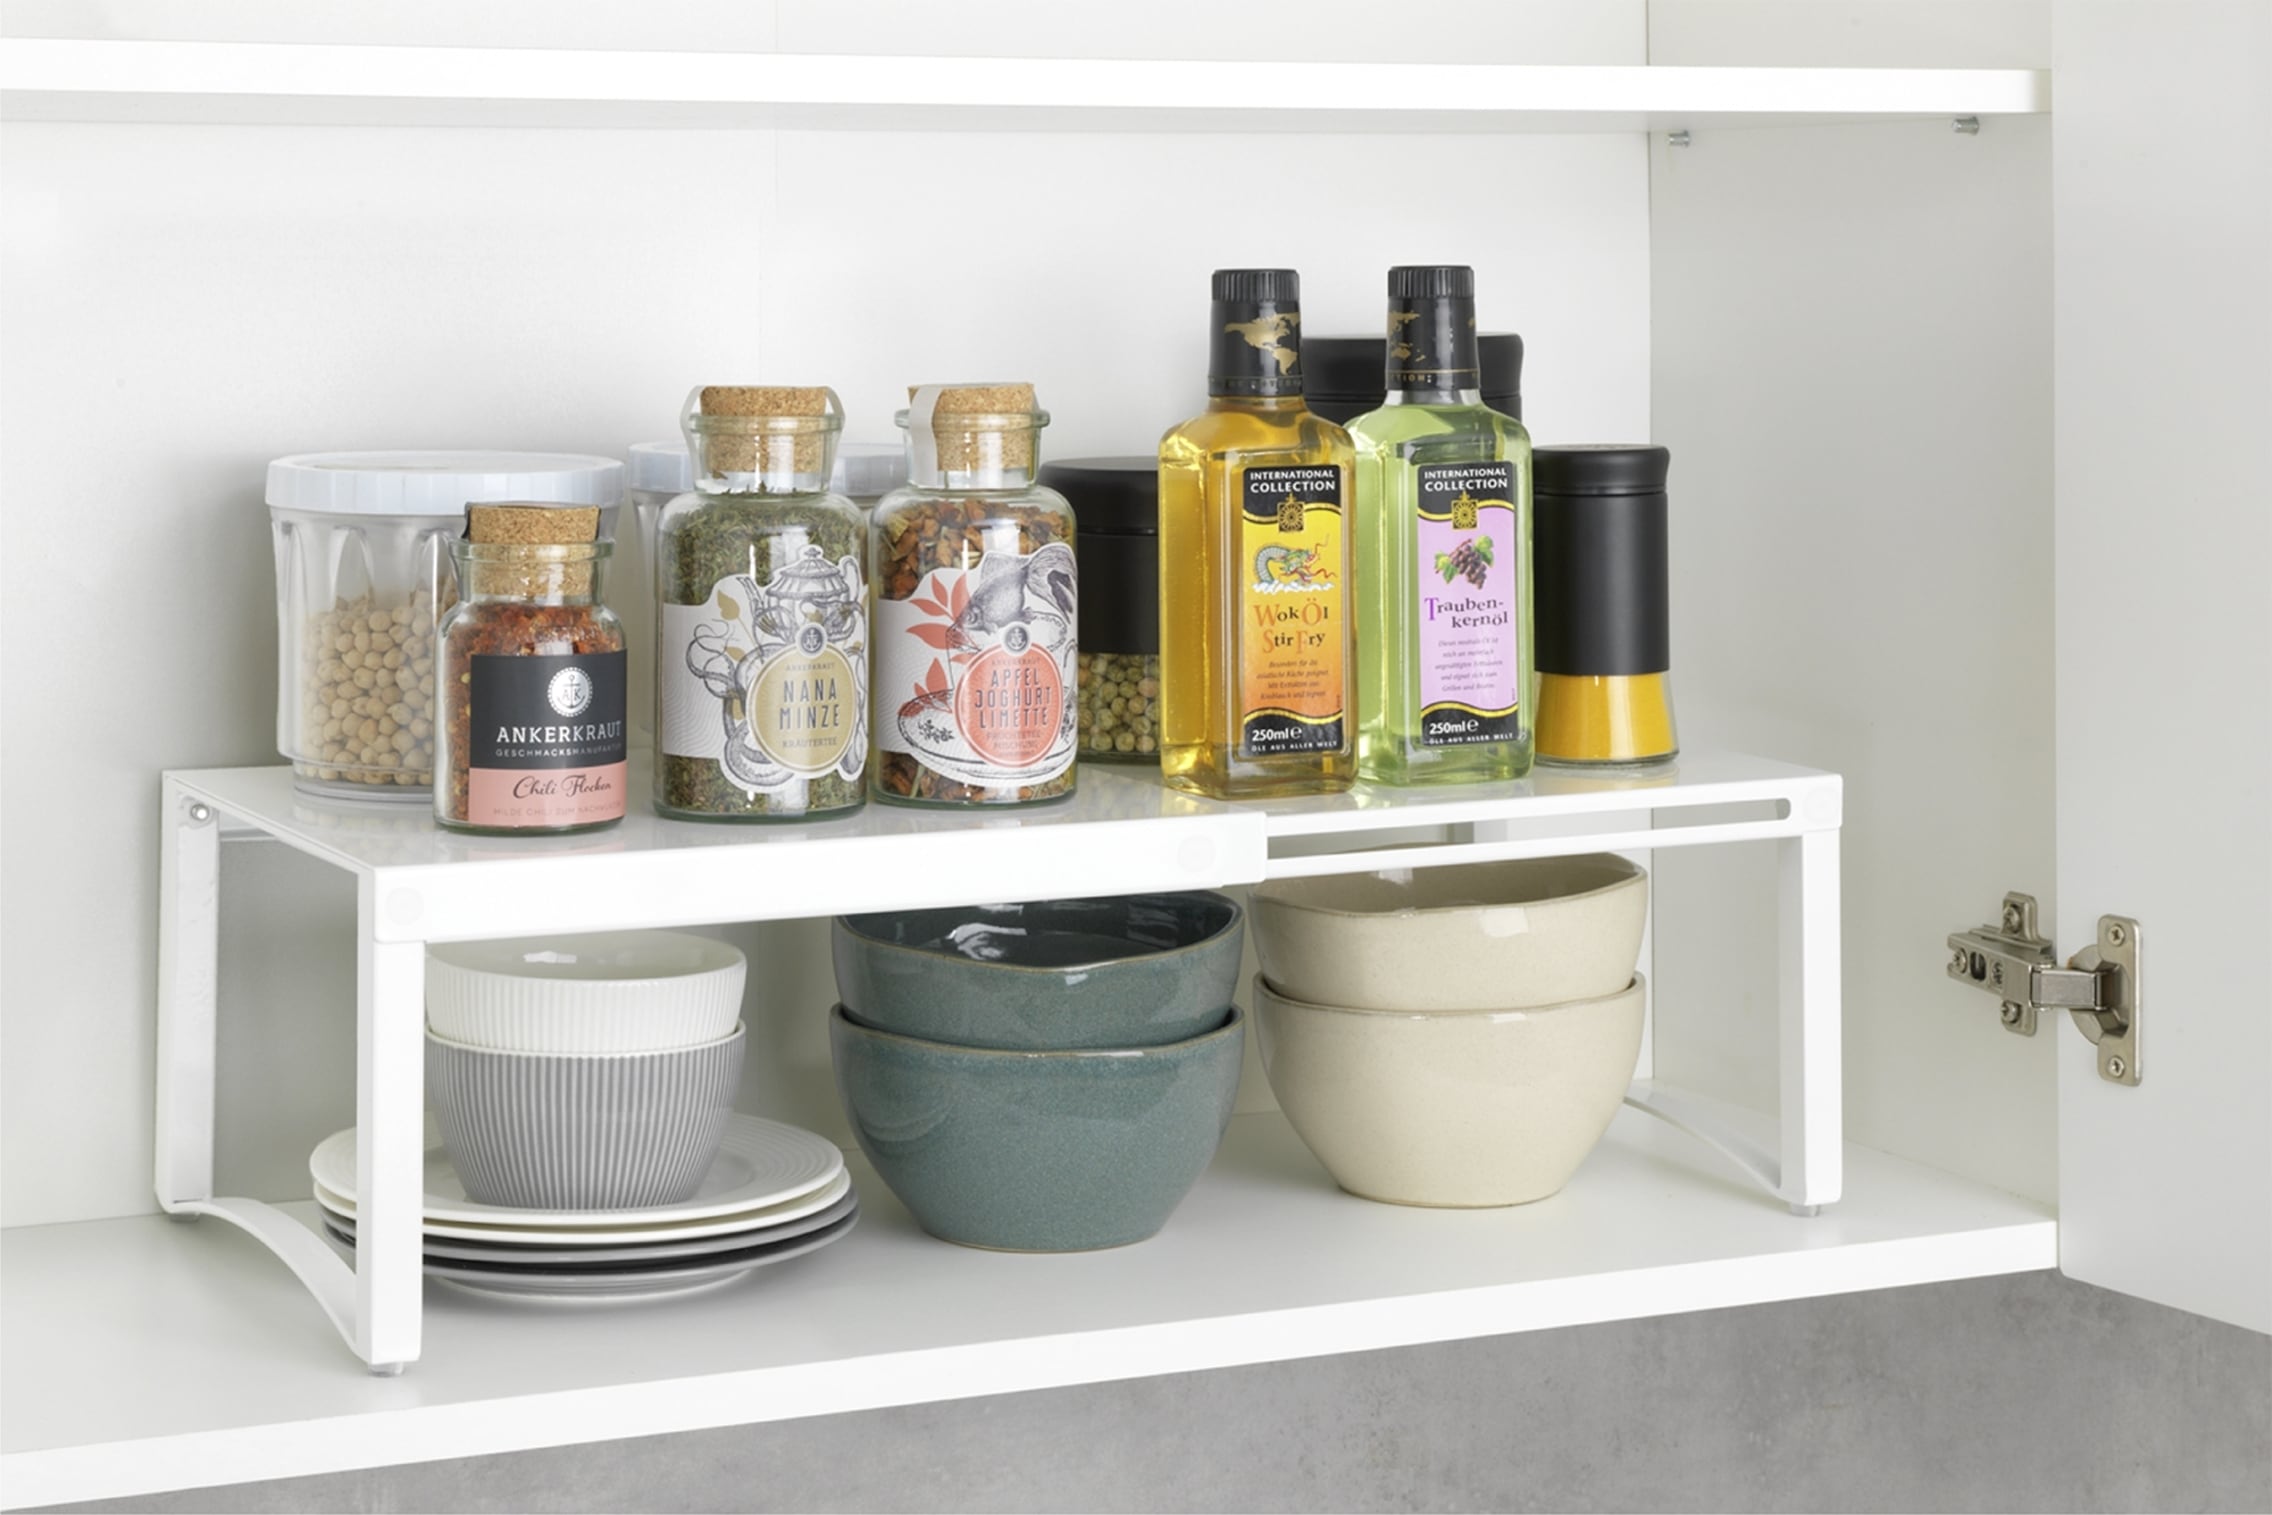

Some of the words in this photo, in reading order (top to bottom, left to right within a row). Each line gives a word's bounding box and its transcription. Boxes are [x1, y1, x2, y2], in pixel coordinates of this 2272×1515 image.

[1250, 469, 1335, 481] INTERNATIONAL
[1424, 468, 1507, 479] INTERNATIONAL
[1250, 481, 1335, 493] COLLECTION
[1424, 478, 1508, 492] COLLECTION
[1424, 597, 1504, 621] Trauben-
[1451, 611, 1508, 629] kernöl
[991, 667, 1039, 687] APFEL
[783, 677, 837, 703] NANA
[974, 686, 1051, 708] JOGHURT
[779, 703, 840, 730] MINZE
[979, 707, 1047, 729] LIMETTE
[496, 721, 621, 743] ANKERKRAUT
[1251, 728, 1289, 742] 250ml
[1429, 720, 1466, 735] 250ml
[1493, 732, 1513, 740] WELT
[1317, 740, 1337, 748] WELT
[512, 774, 557, 799] Chili
[560, 773, 612, 798] Flocken
